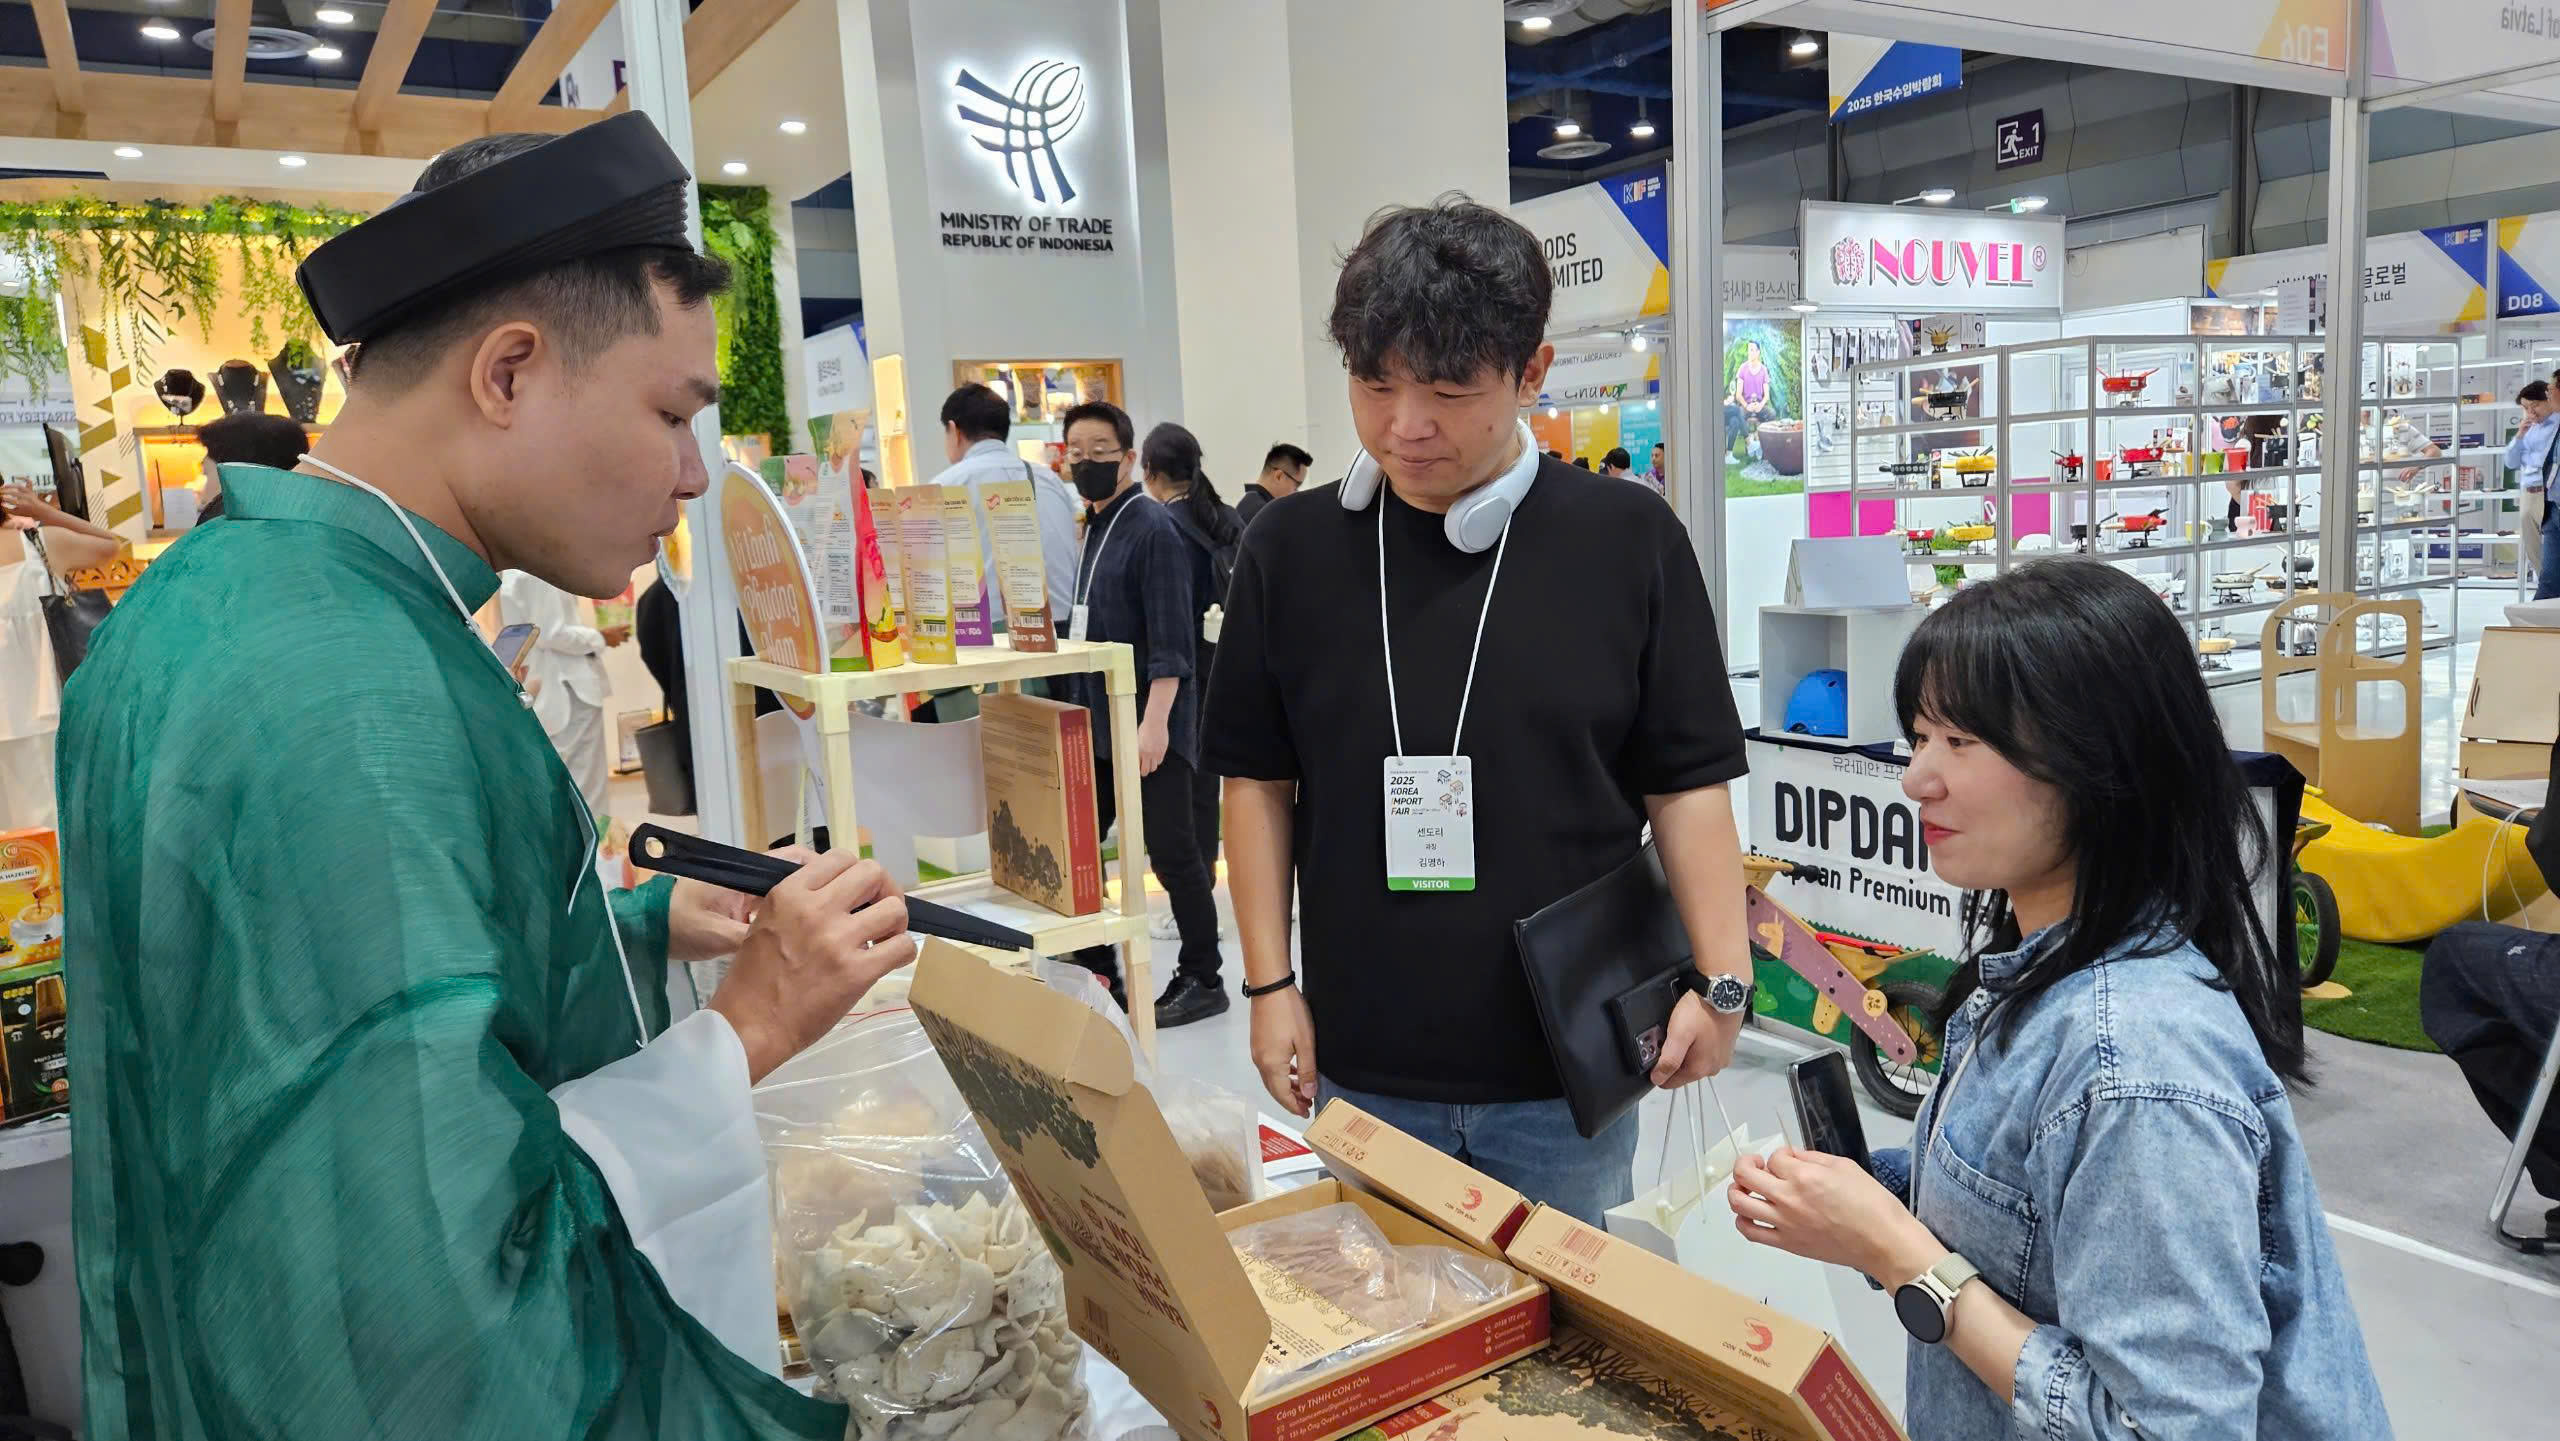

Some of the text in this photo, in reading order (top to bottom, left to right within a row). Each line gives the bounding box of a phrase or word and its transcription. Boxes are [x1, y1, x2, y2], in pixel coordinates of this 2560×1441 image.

[1847, 73, 1942, 114] 2025 한국수입박람회
[2032, 122, 2040, 144] 1
[2019, 145, 2039, 159] EXIT
[1624, 179, 1647, 204] KIF
[940, 212, 1113, 235] MINISTRY OF TRADE
[942, 233, 1114, 252] REPUBLIC OF INDONESIA
[1544, 232, 1577, 260] ODS
[1551, 257, 1603, 290] MITED
[2508, 292, 2543, 312] D08
[1833, 756, 1880, 778] 유러피안
[1390, 776, 1415, 786] 2025
[1390, 787, 1419, 796] KOREA
[1391, 797, 1424, 806] IMPORT
[1391, 807, 1410, 816] FAIR
[1412, 879, 1450, 889] VISITOR
[1849, 866, 1951, 918] Premium
[1276, 1376, 1370, 1422] Công ty TNHH CON TÔM
